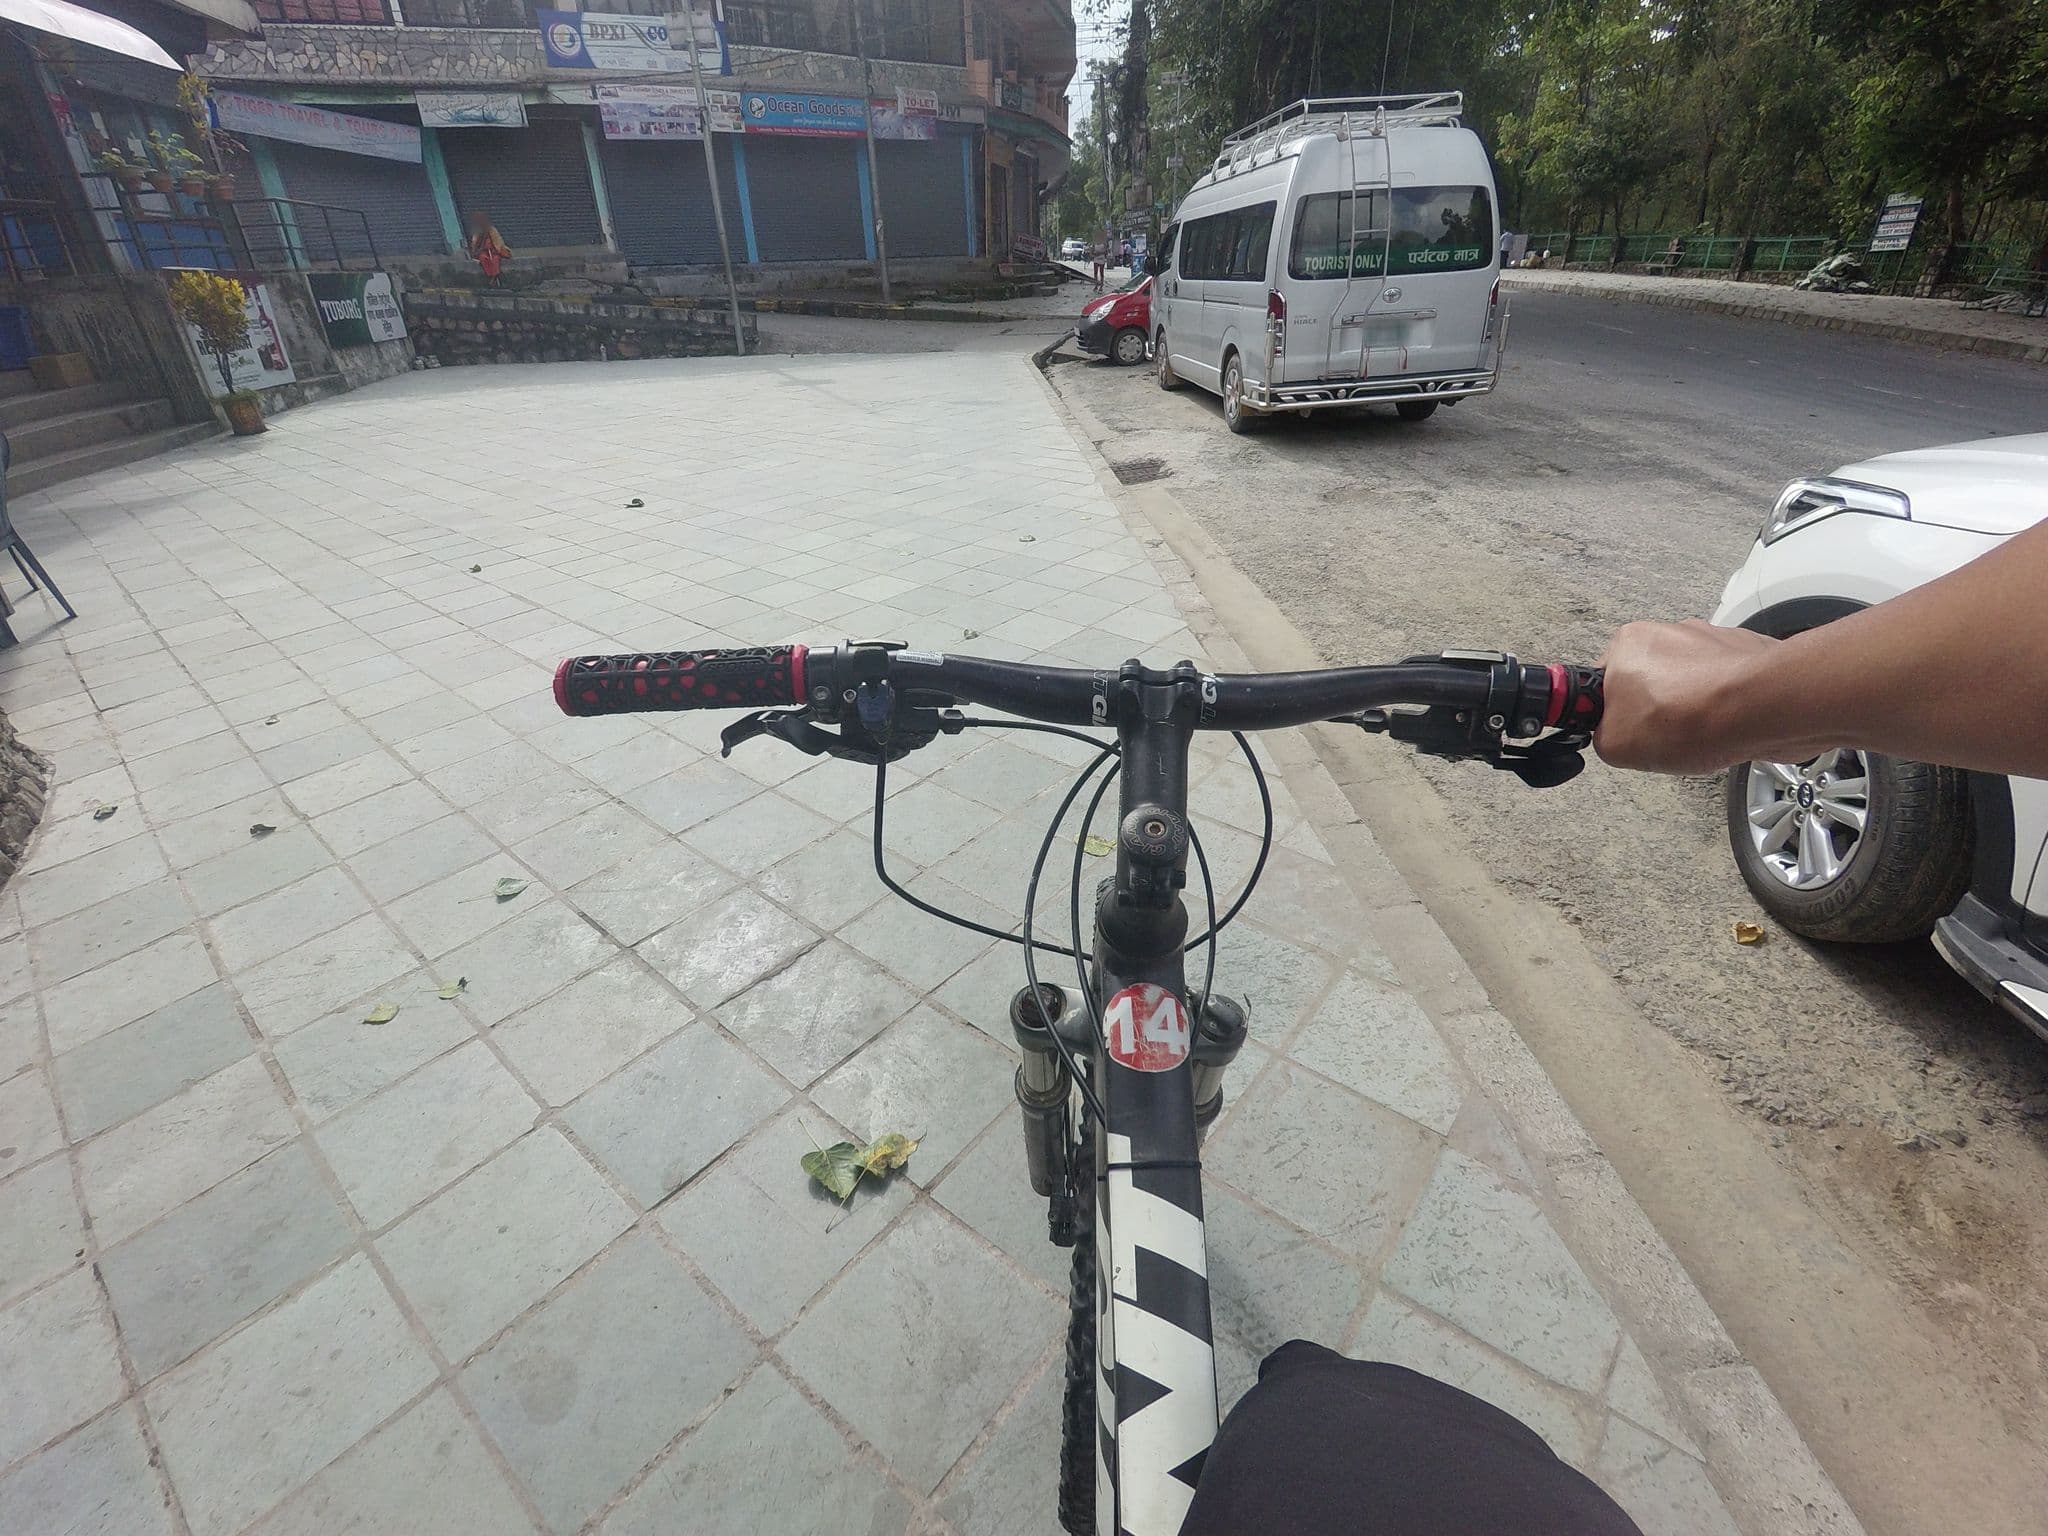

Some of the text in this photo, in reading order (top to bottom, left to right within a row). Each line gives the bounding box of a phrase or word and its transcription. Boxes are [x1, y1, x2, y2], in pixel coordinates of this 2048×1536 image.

[808, 98, 846, 117] Goods
[1304, 254, 1384, 272] TOURIST ONLY
[1408, 247, 1480, 265] पर्यटक मात्र
[319, 298, 363, 323] TUBORG
[1104, 996, 1187, 1055] 14
